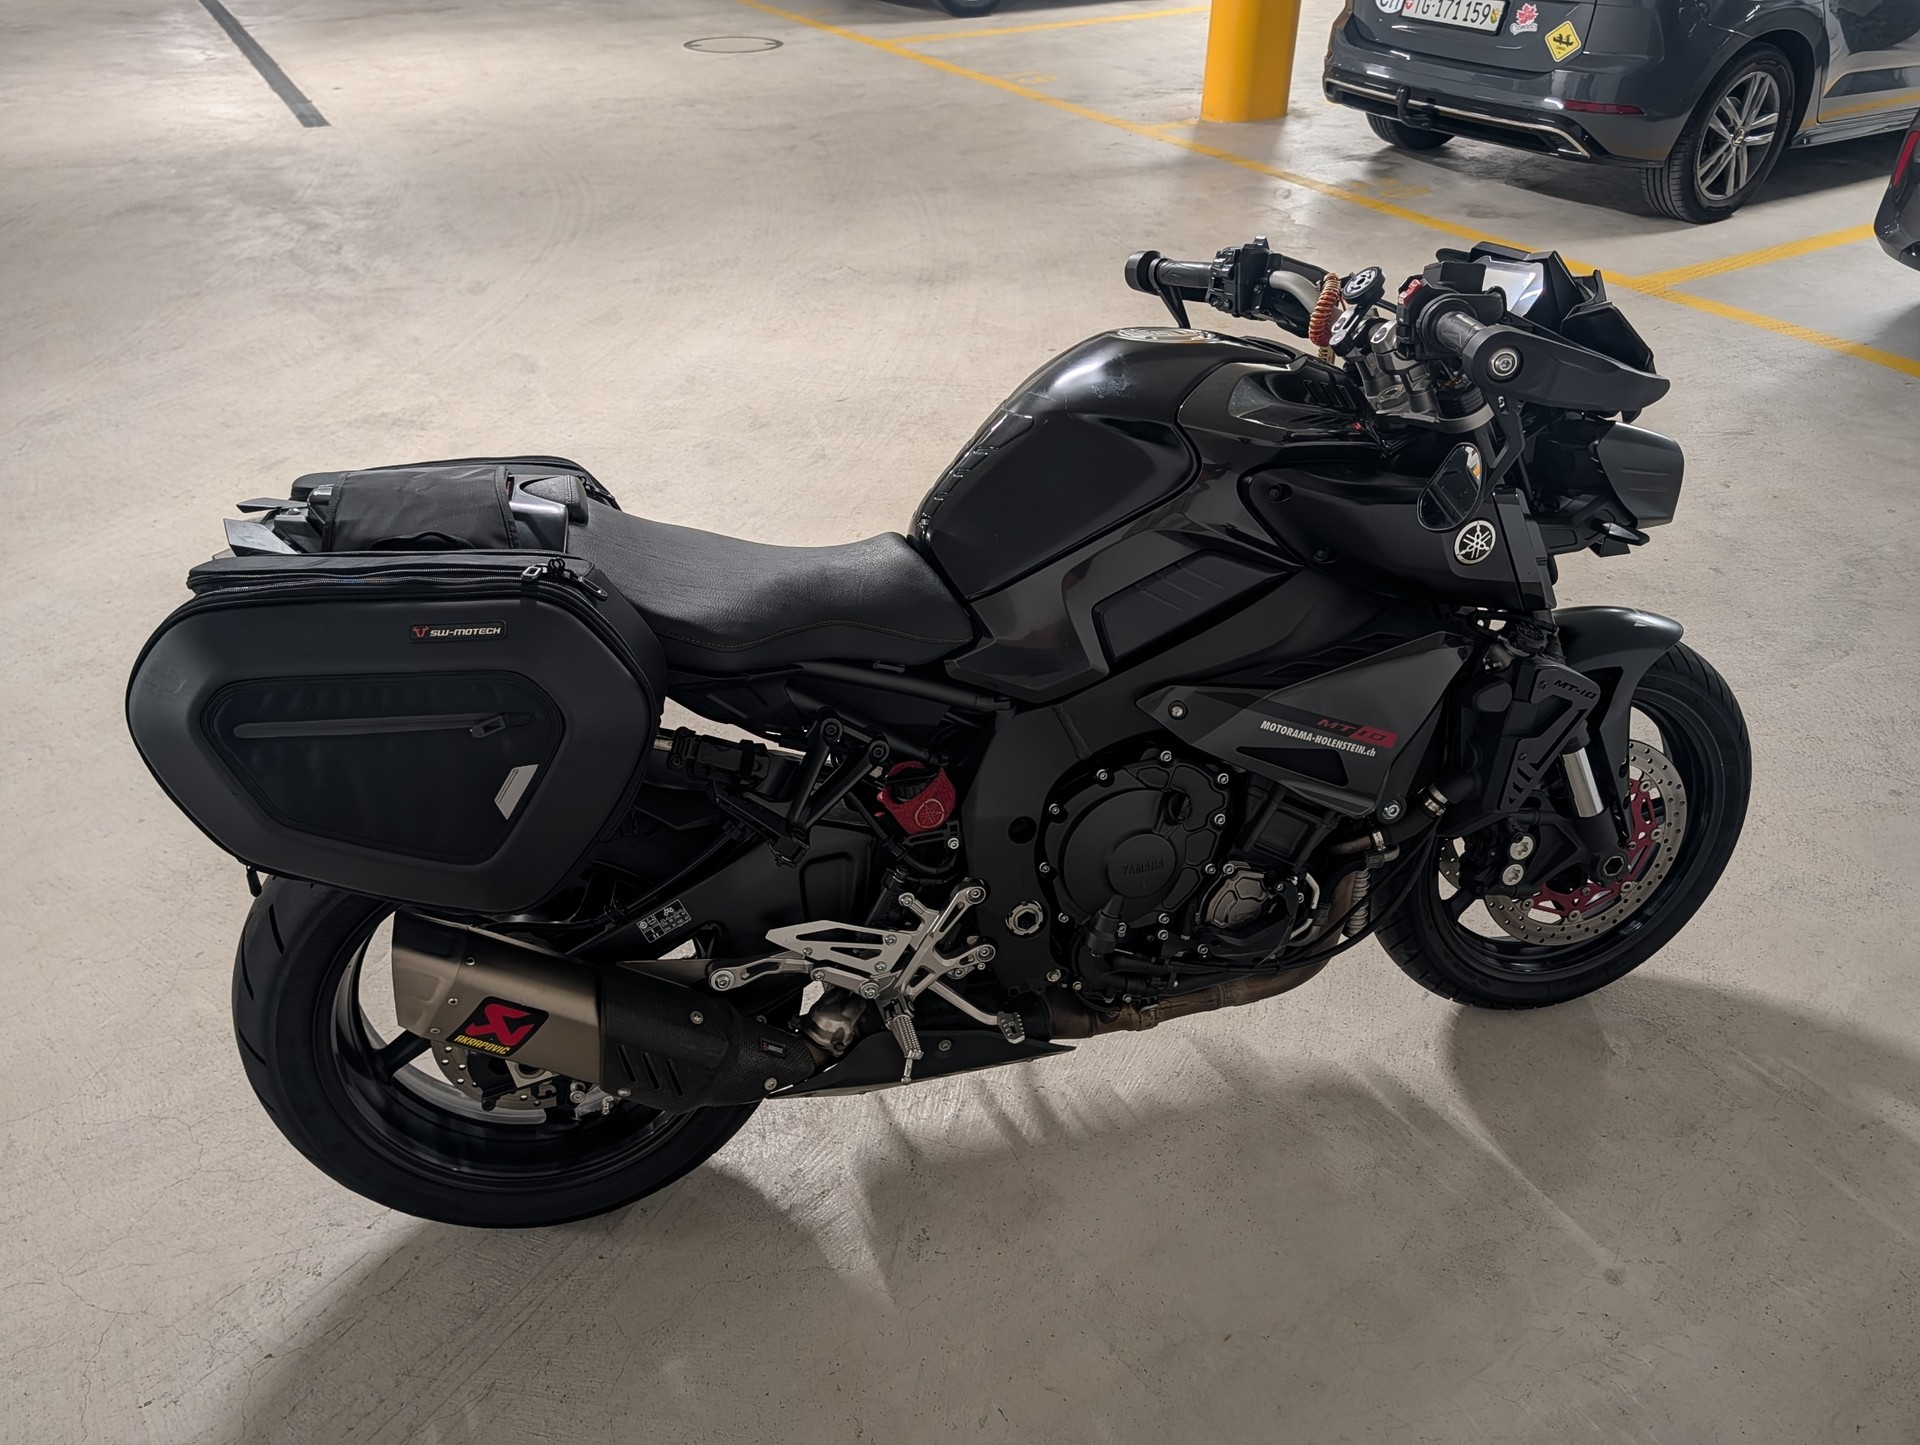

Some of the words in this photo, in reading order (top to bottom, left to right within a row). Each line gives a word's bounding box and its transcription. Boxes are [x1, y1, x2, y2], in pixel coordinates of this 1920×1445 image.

[429, 626, 502, 637] SW-MOTECH
[1553, 679, 1598, 700] MT-10
[1260, 720, 1376, 757] MOTORAMA-HOLENSTEIN.ch
[1122, 859, 1165, 875] YAMAHA
